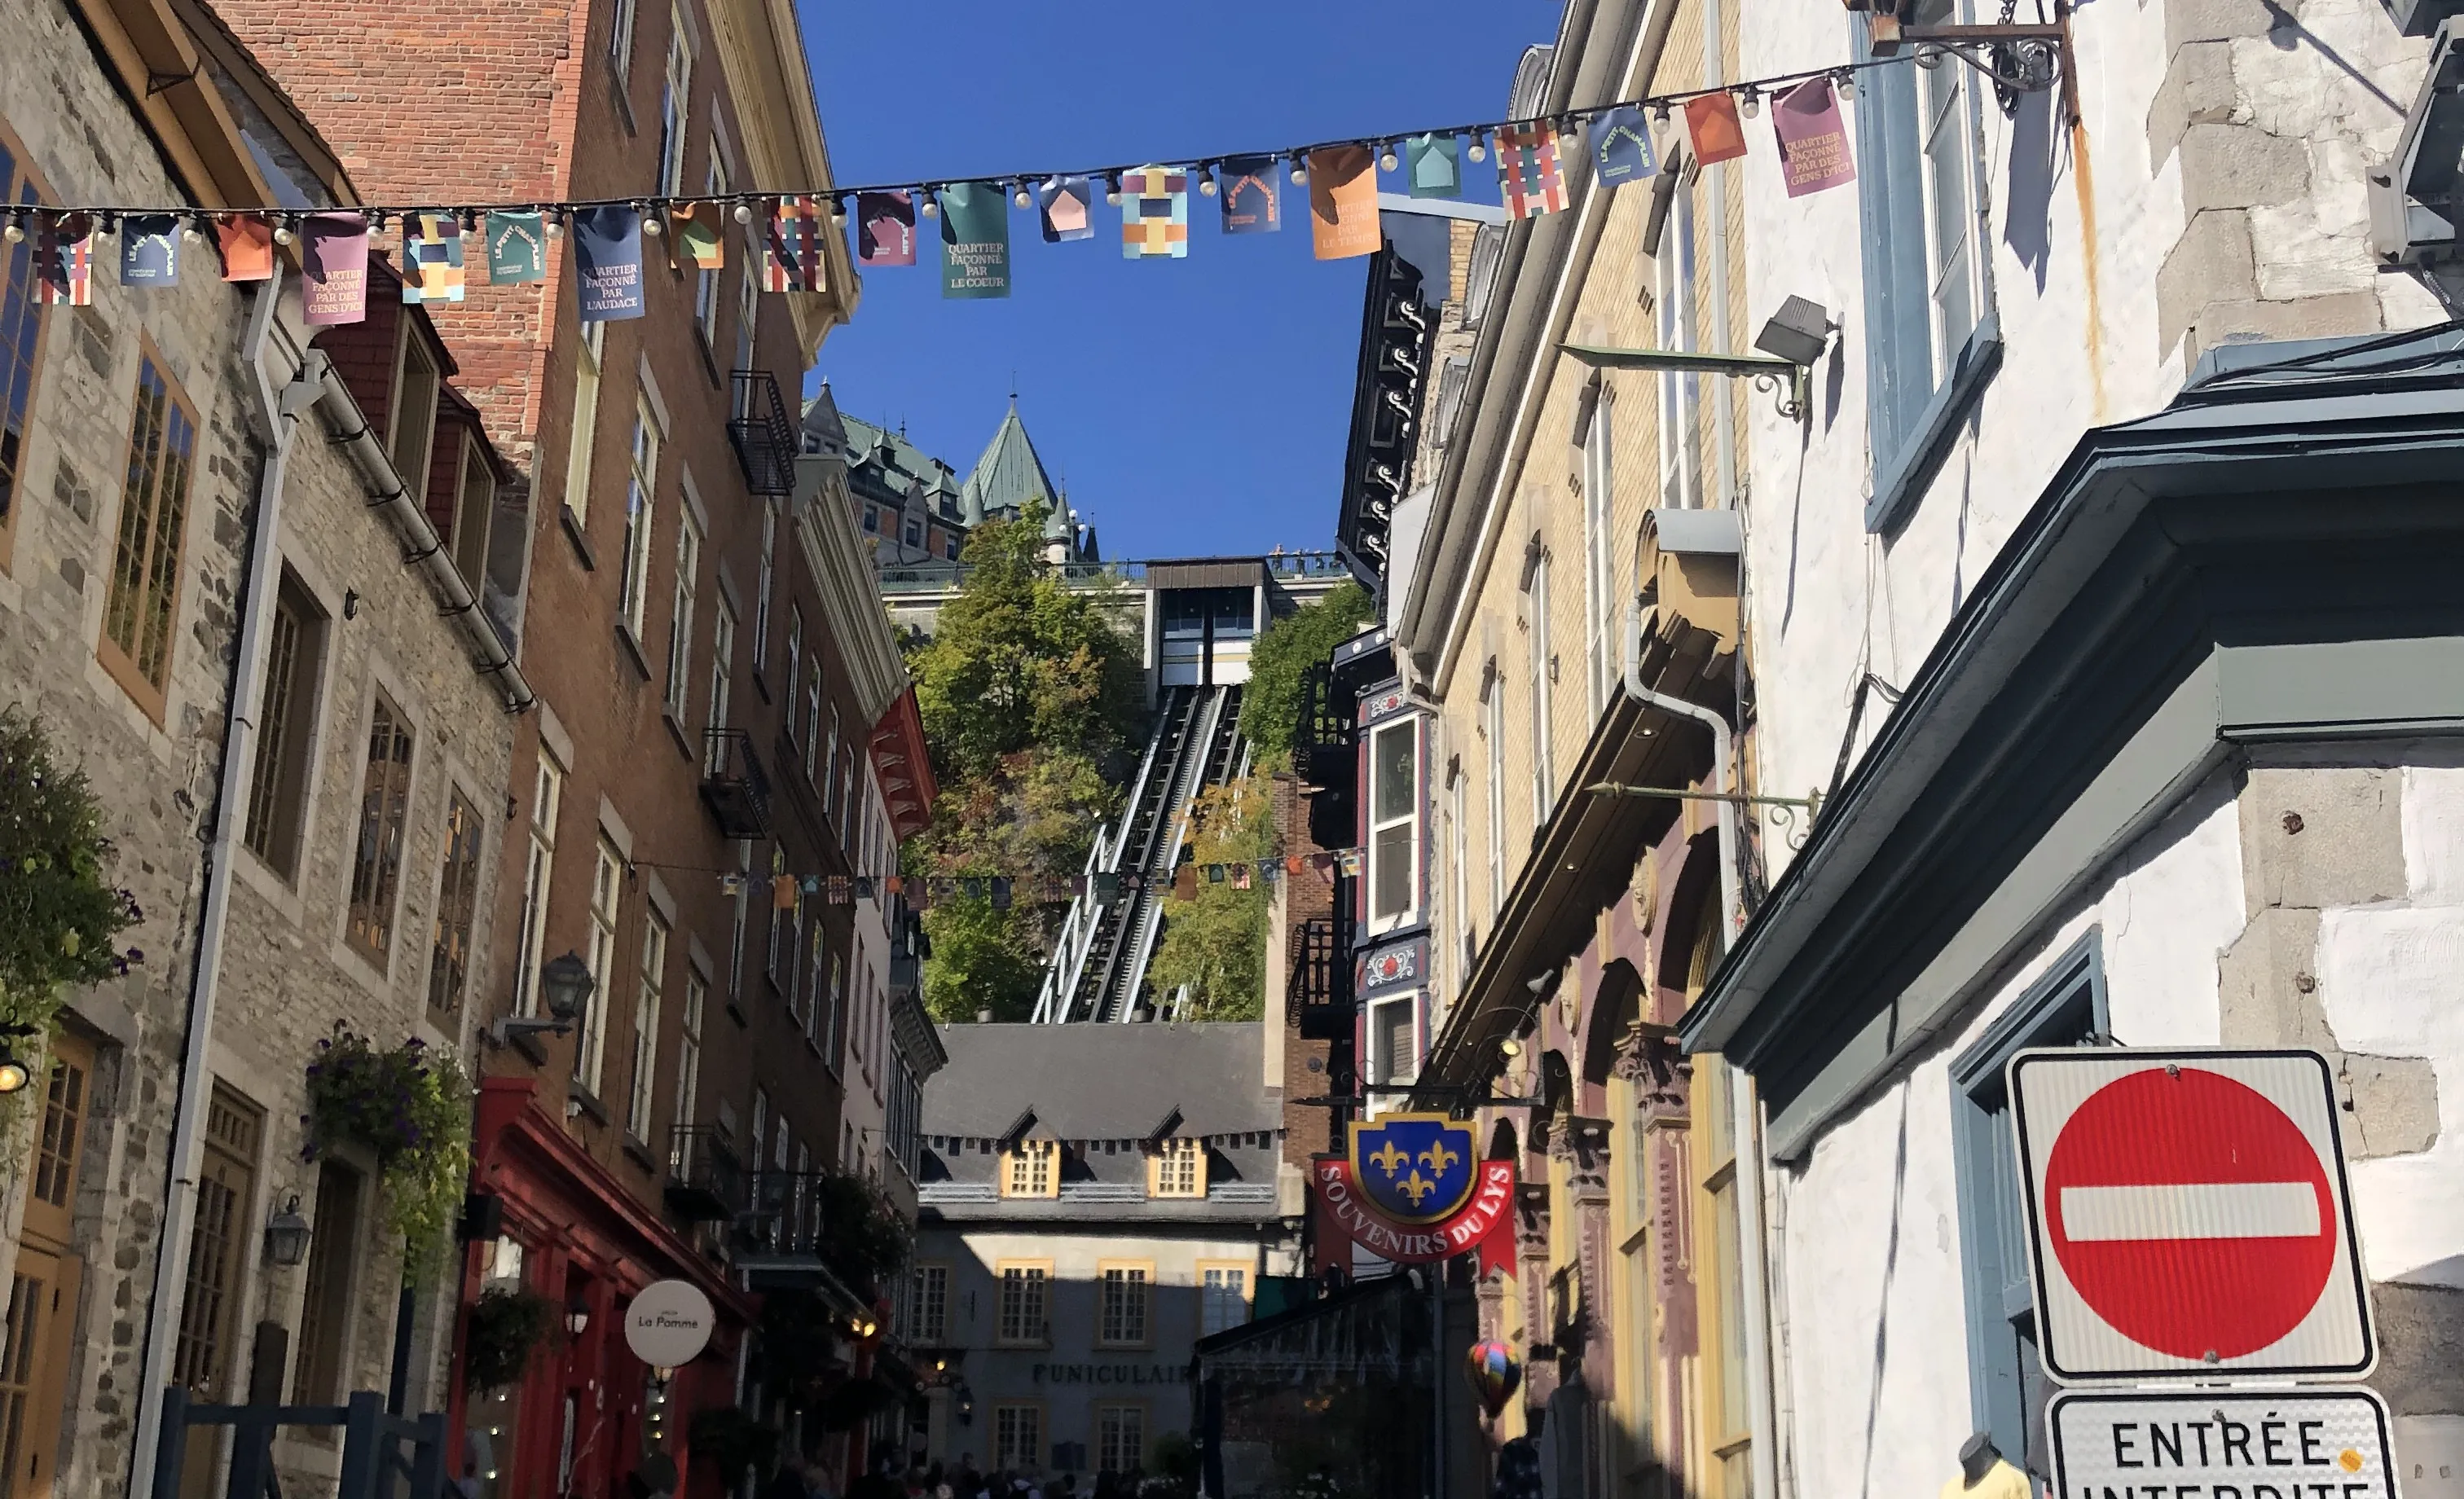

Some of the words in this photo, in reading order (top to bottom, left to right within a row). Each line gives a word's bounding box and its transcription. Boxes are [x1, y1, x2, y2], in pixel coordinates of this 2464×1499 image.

[1784, 131, 1841, 152] QUARTIER
[1789, 141, 1841, 163] FAÇONNÉ
[1795, 160, 1817, 174] PAR
[1819, 154, 1841, 168] DES
[1790, 169, 1822, 186] GENS
[1823, 162, 1850, 178] D'ICI
[948, 243, 1004, 256] QUARTIER
[583, 264, 637, 278] QUARTIER
[966, 266, 988, 276] PAR
[951, 278, 965, 288] LE
[966, 277, 1004, 288] COEUR
[316, 292, 337, 302] PAR
[338, 291, 359, 301] DES
[602, 288, 623, 298] PAR
[309, 303, 338, 314] GENS
[587, 297, 637, 310] L'AUDACE
[1321, 1167, 1448, 1255] SOUVENIRS
[1451, 1212, 1484, 1245] DU
[1476, 1167, 1509, 1219] LYS
[639, 1316, 652, 1327] La
[656, 1317, 698, 1329] Pomme
[2112, 1411, 2330, 1467] ENTRÉE
